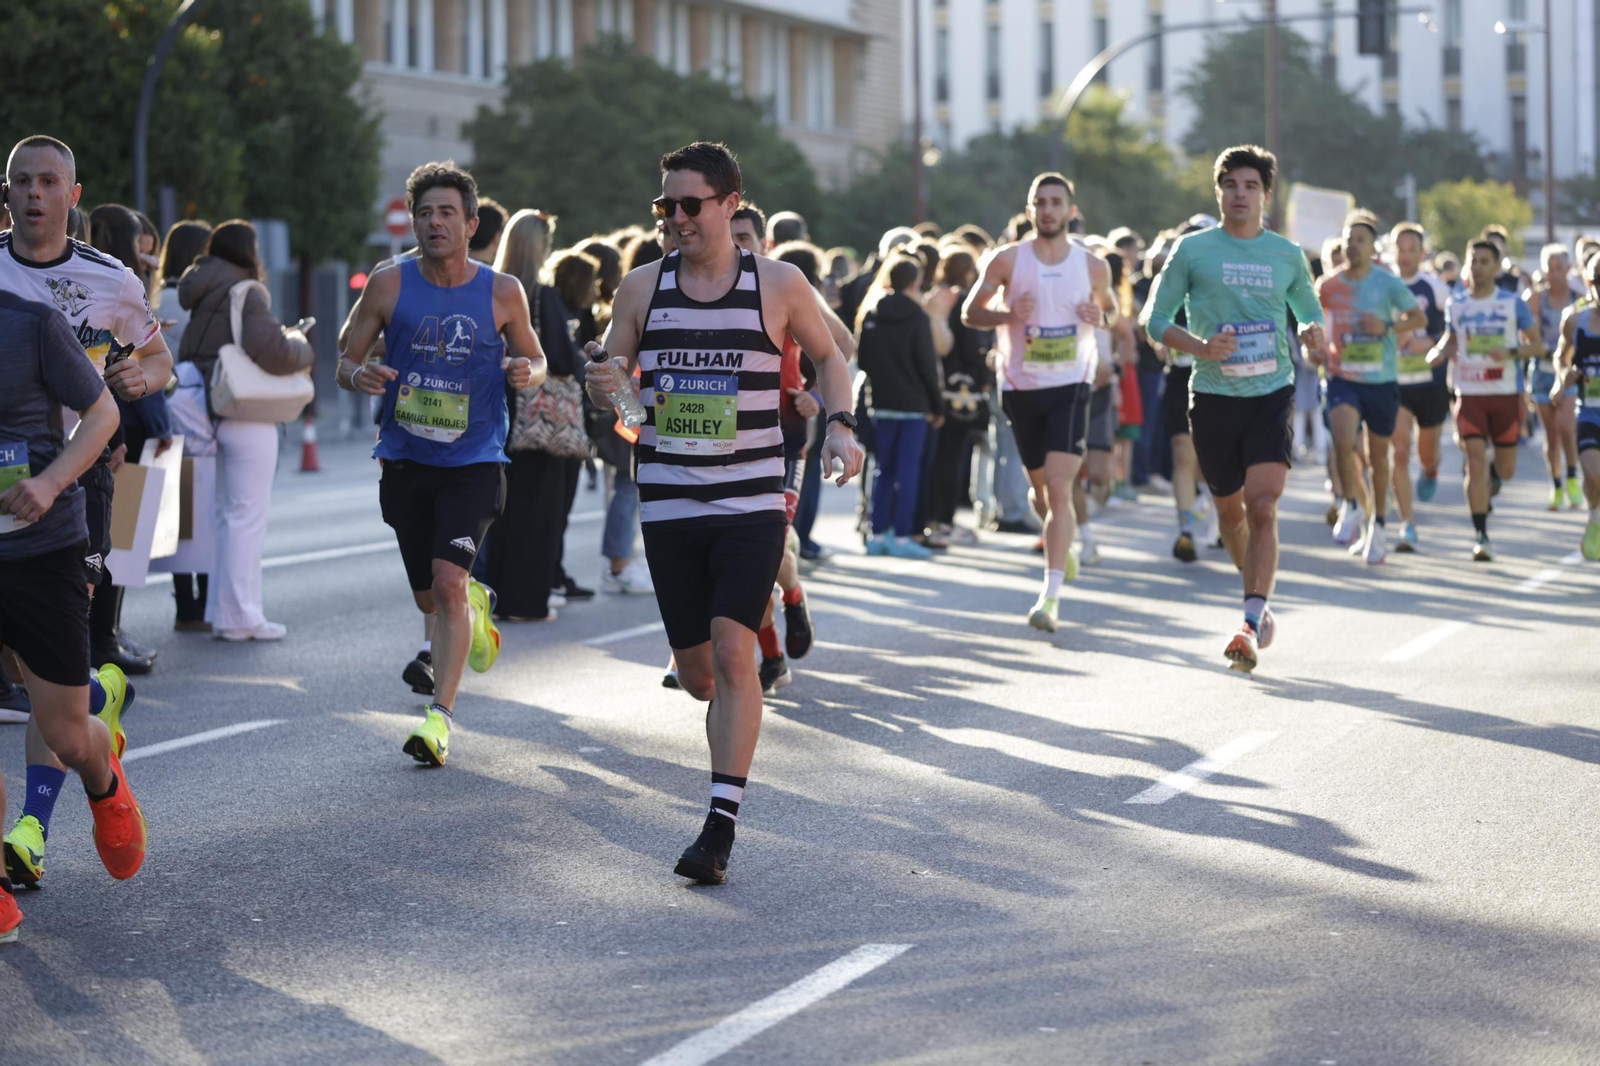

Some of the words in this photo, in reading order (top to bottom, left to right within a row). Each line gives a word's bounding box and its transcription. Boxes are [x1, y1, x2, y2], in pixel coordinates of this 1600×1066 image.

[1222, 276, 1274, 289] CASCAIS
[1238, 323, 1270, 334] ZURICH
[411, 343, 439, 352] Maratón
[446, 344, 471, 354] Sevilla
[657, 351, 744, 368] FULHAM
[1253, 351, 1275, 363] LUCAS
[424, 378, 462, 391] ZURICH
[679, 379, 727, 391] ZURICH
[423, 397, 442, 408] 2141
[679, 402, 705, 414] 2428
[396, 410, 429, 424] SAMUEL
[432, 417, 466, 429] HADJES
[665, 417, 723, 435] ASHLEY
